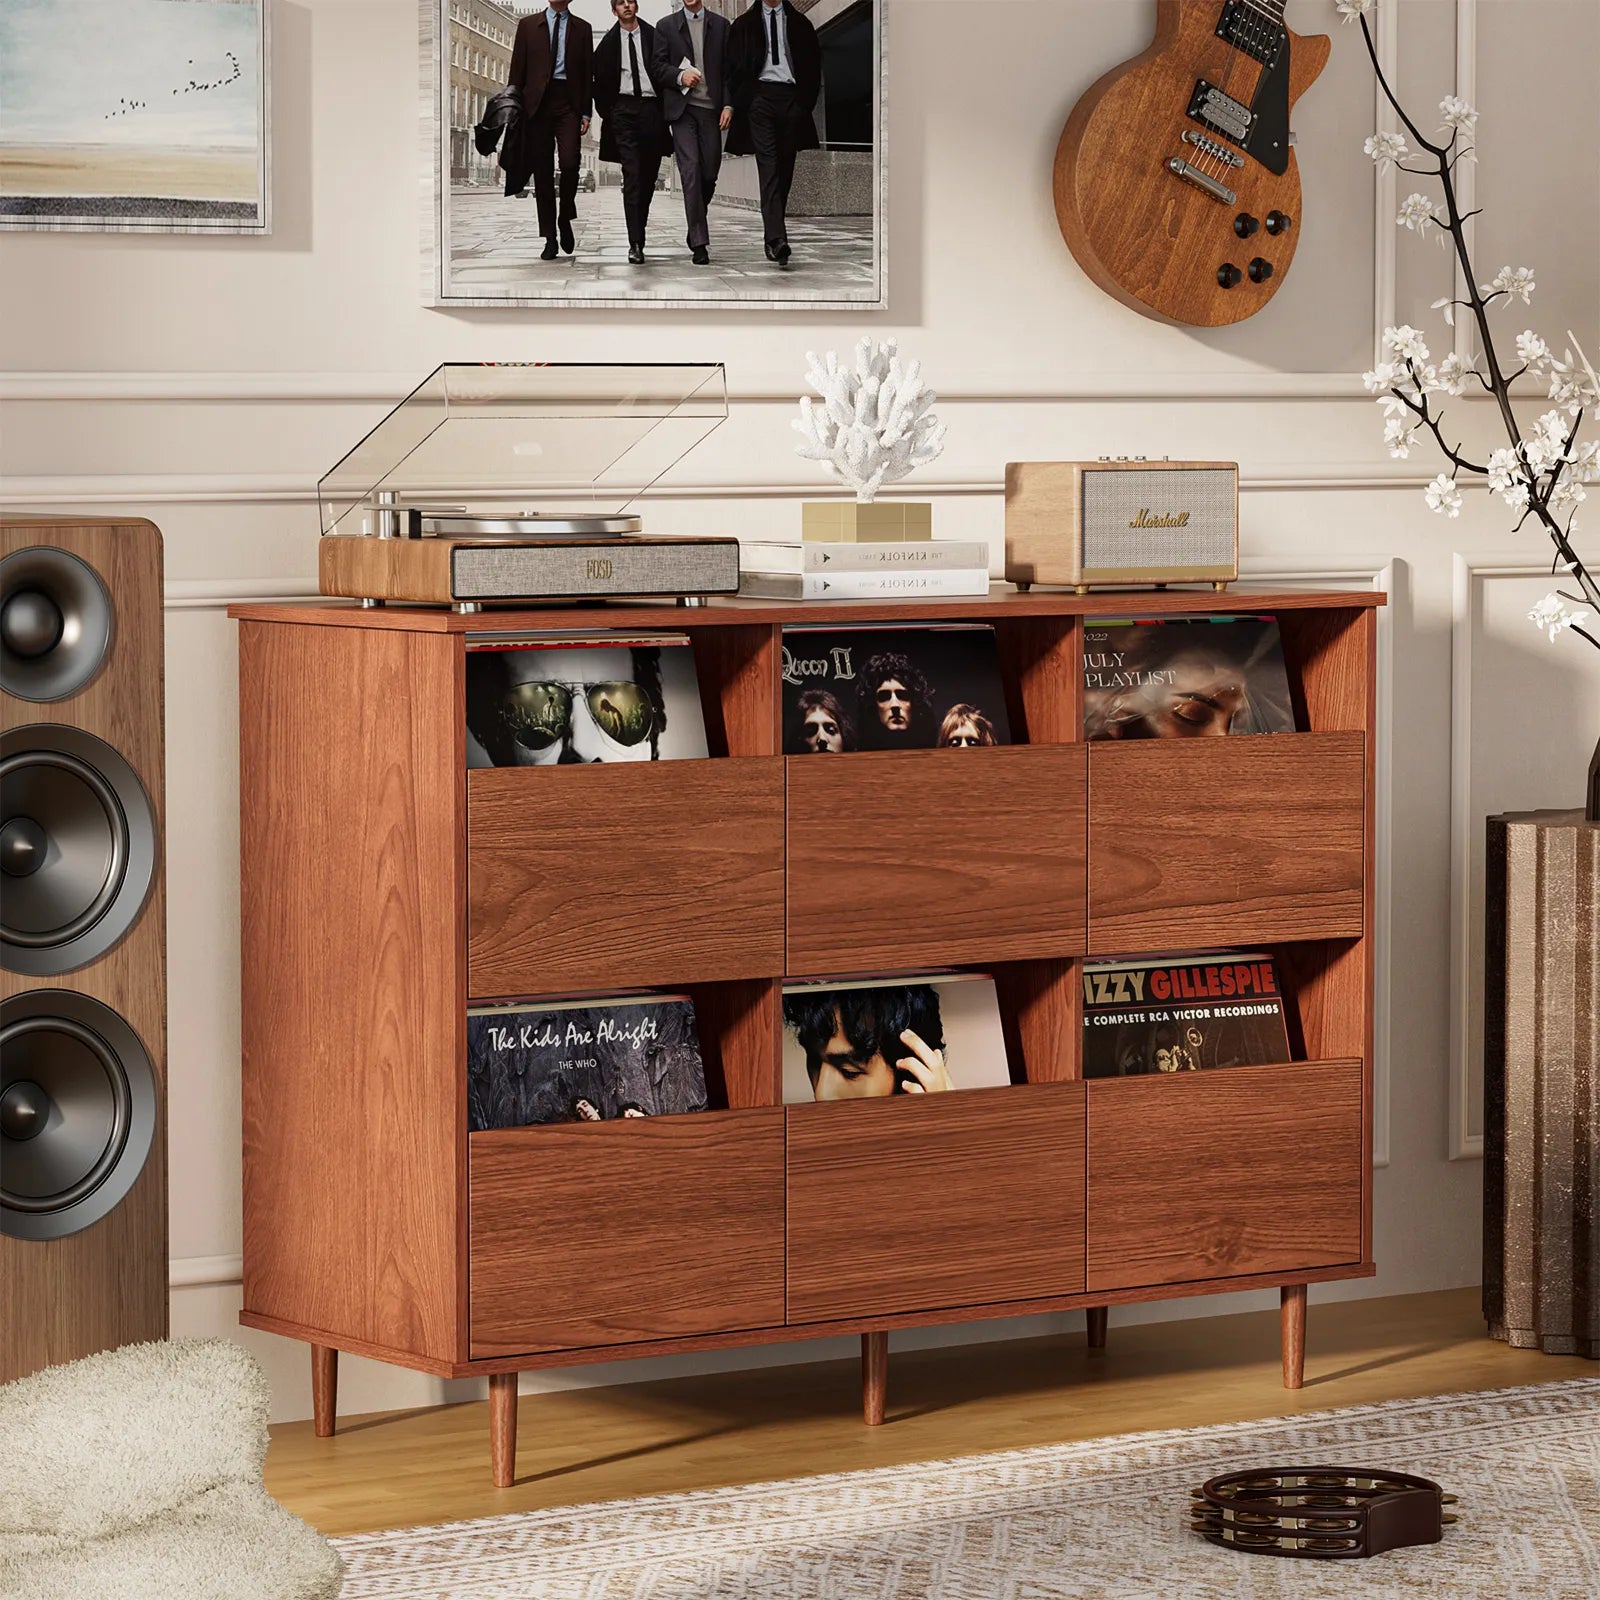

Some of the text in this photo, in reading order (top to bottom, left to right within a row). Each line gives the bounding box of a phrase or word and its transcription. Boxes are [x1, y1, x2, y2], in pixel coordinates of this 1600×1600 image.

[1128, 507, 1190, 528] Marshall
[1083, 632, 1108, 642] 022
[1083, 652, 1125, 671] JULY
[1085, 670, 1176, 688] PLAYLIST
[1083, 964, 1277, 1005] IZZY GILLESPIE
[1094, 1013, 1146, 1026] COMPLETE
[1150, 1011, 1170, 1022] RCA
[1173, 1008, 1211, 1021] VICTOR
[1214, 1004, 1280, 1018] RECORDINGS
[488, 1017, 659, 1051] The Kids Are Alright
[558, 1058, 597, 1070] THE WHO
